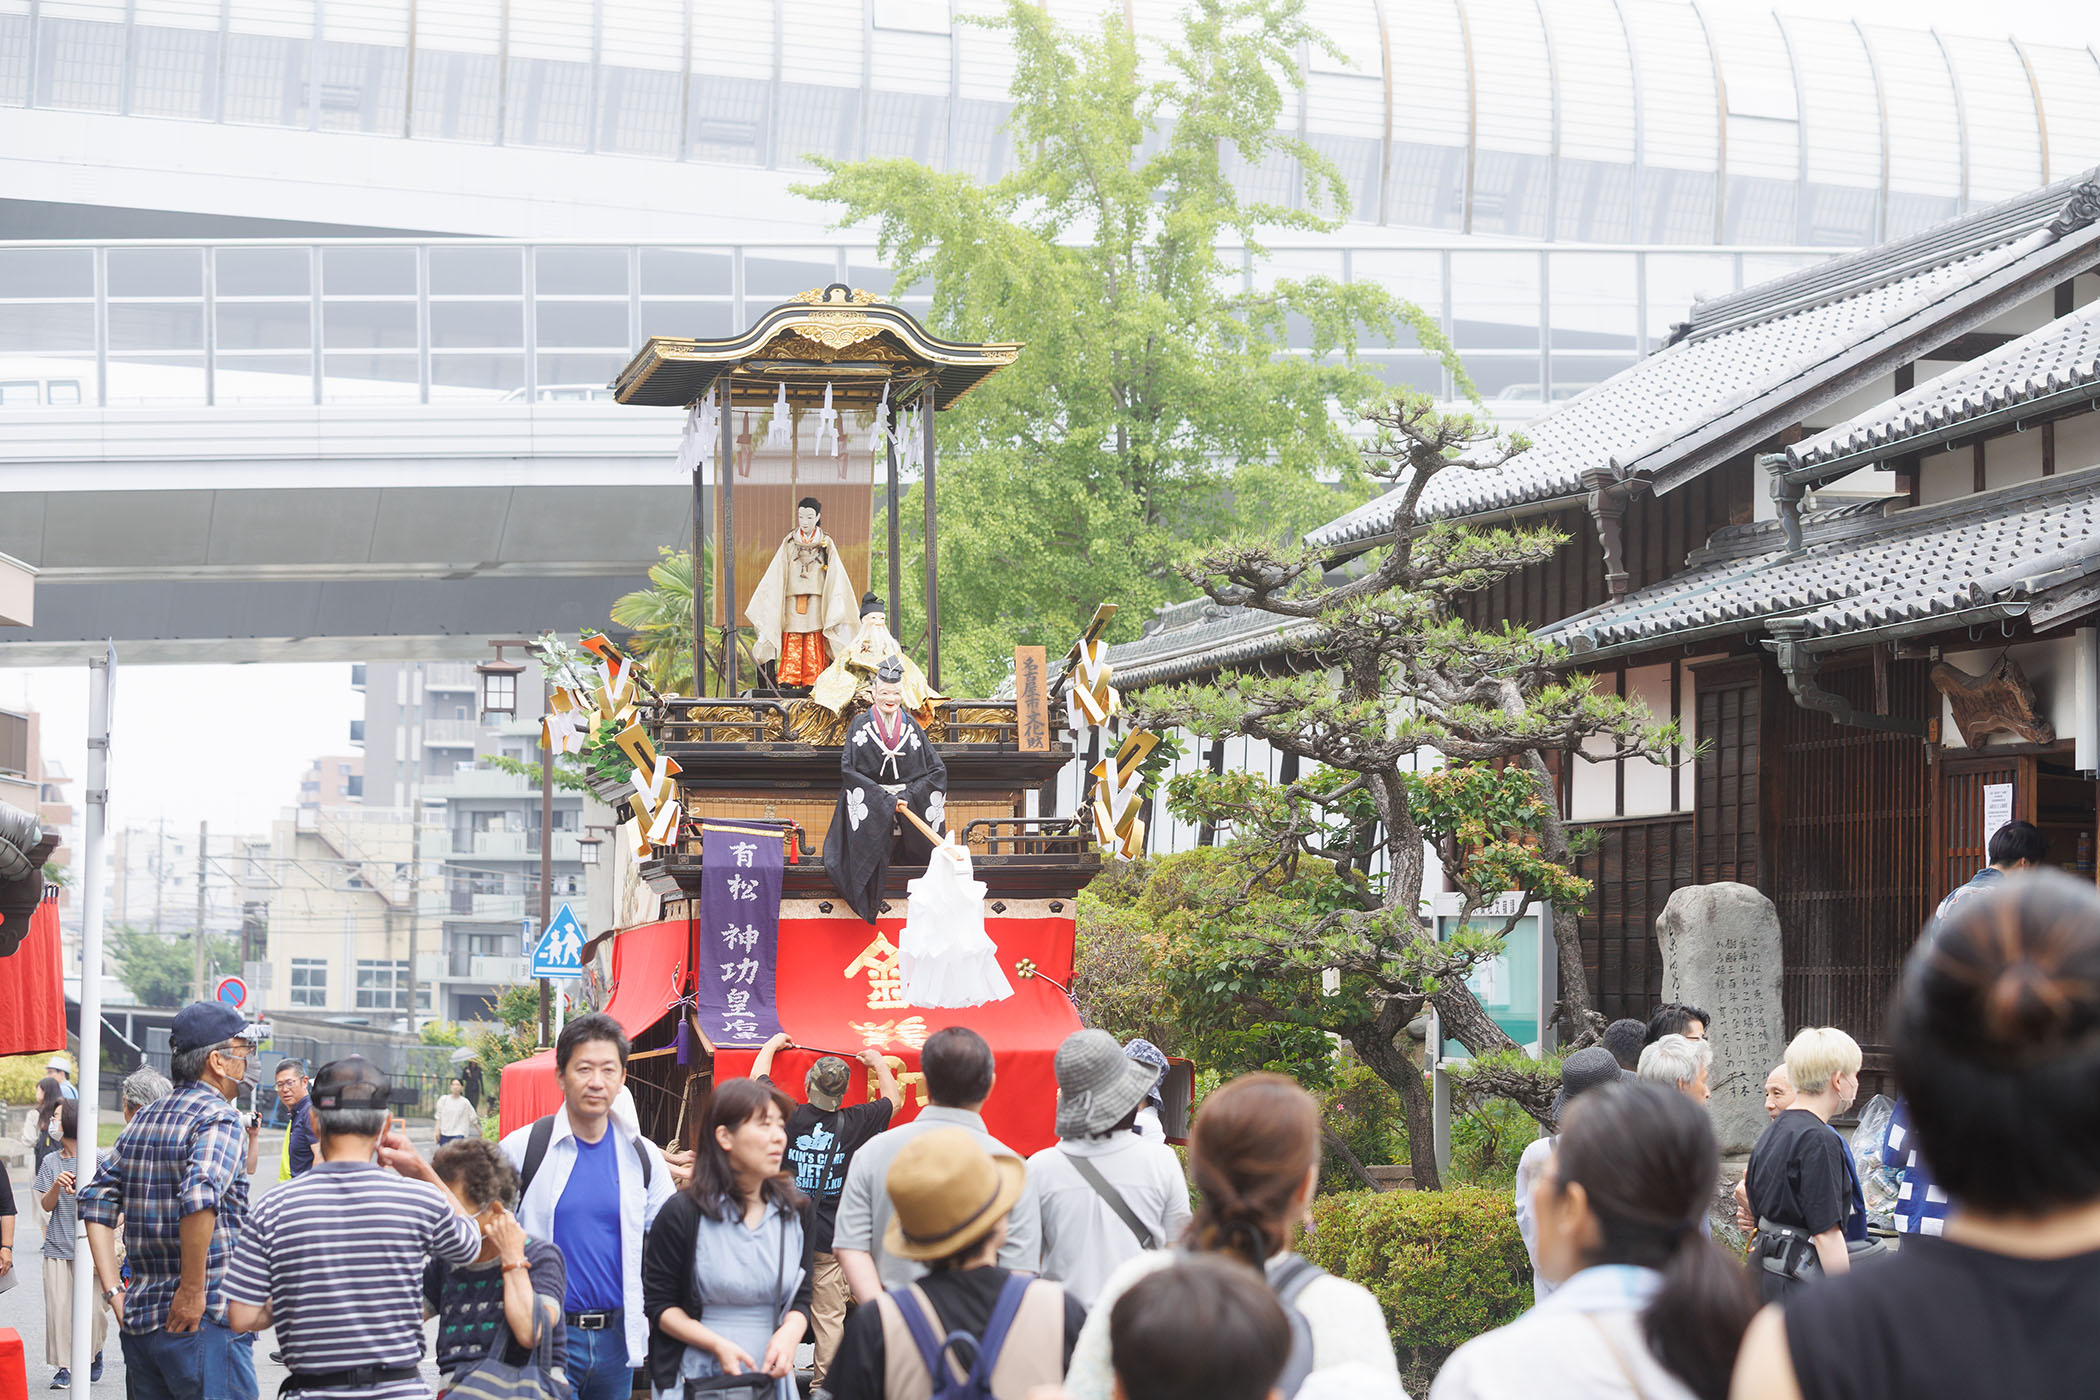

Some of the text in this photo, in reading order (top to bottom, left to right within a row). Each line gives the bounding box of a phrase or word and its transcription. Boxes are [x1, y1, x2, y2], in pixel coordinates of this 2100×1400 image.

[1021, 656, 1045, 749] 名古屋市文化財
[727, 841, 760, 902] 有松
[788, 1148, 815, 1164] KIN'S
